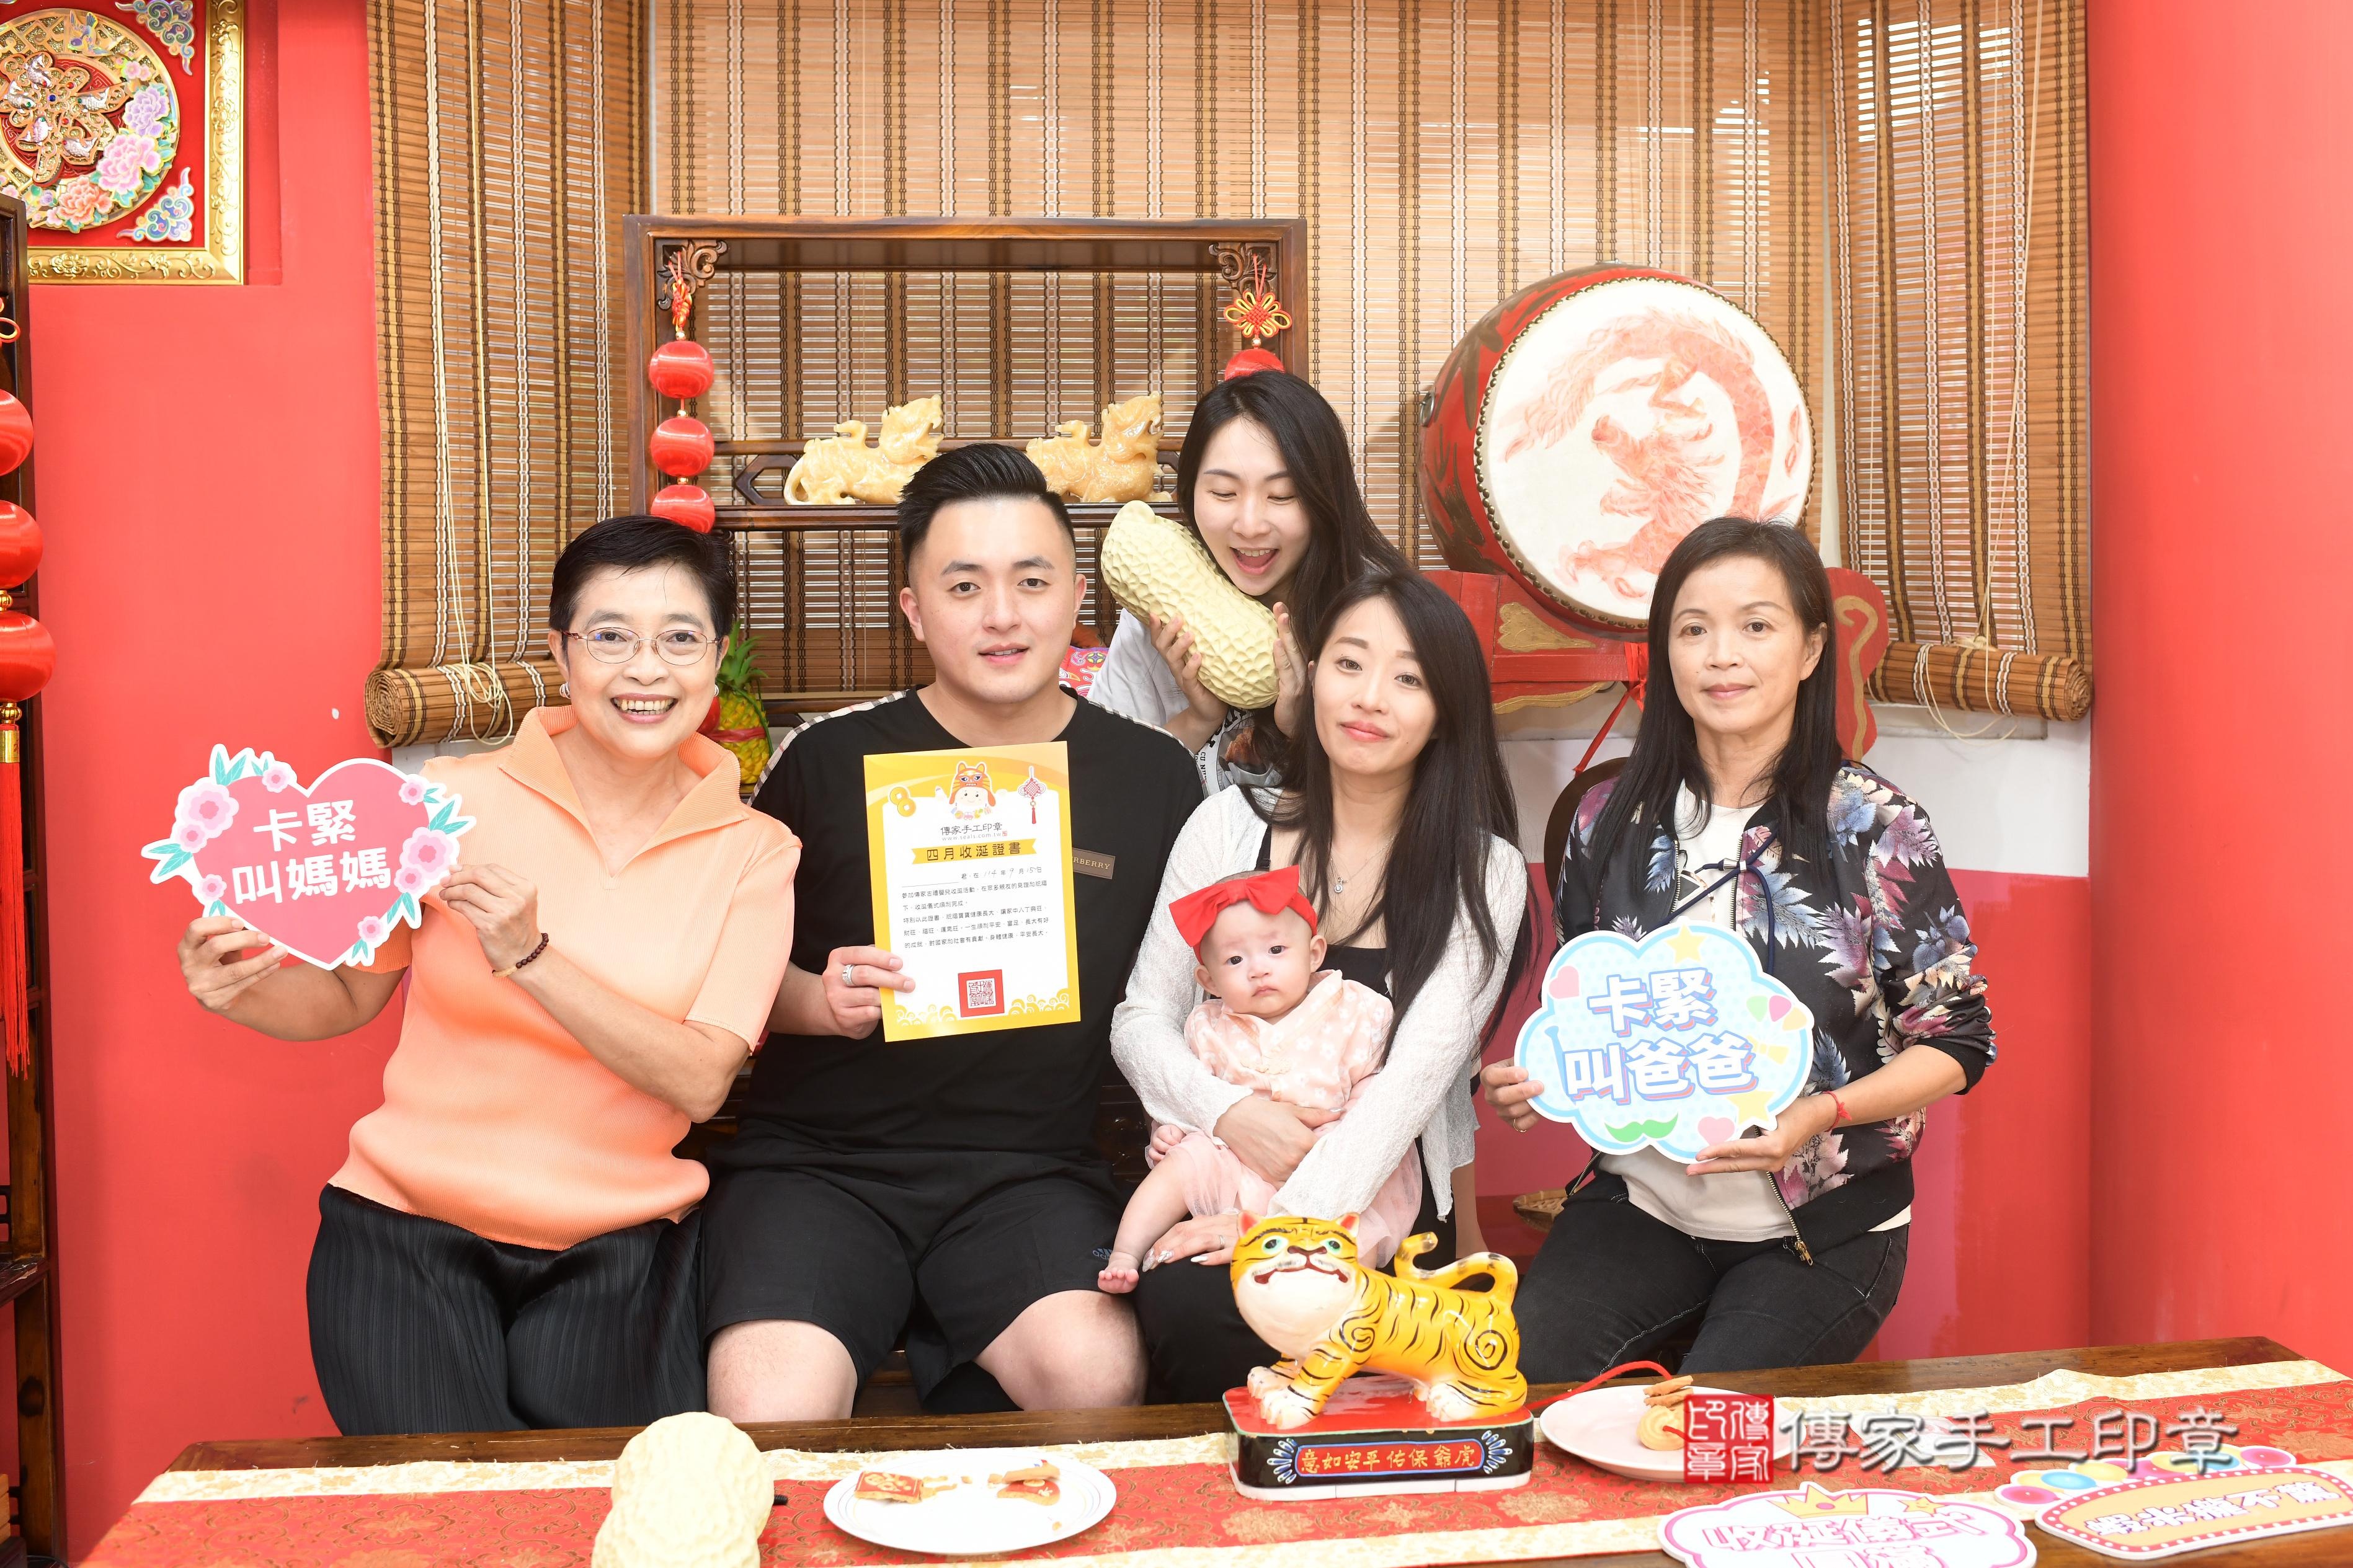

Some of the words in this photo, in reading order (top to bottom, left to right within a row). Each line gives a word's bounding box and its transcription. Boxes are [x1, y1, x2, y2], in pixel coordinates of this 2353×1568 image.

[252, 799, 358, 852] 卡緊
[940, 822, 1003, 836] 傳家手工印章
[941, 832, 1002, 841] www.seals.com.tw
[927, 842, 1021, 862] 四月收涎證書
[1072, 857, 1111, 870] RBERRY
[232, 846, 391, 905] 叫媽媽
[1587, 967, 1717, 1037] 卡緊
[1564, 1030, 1759, 1105] 叫爸爸
[1702, 1512, 1989, 1551] 收涎儀式
